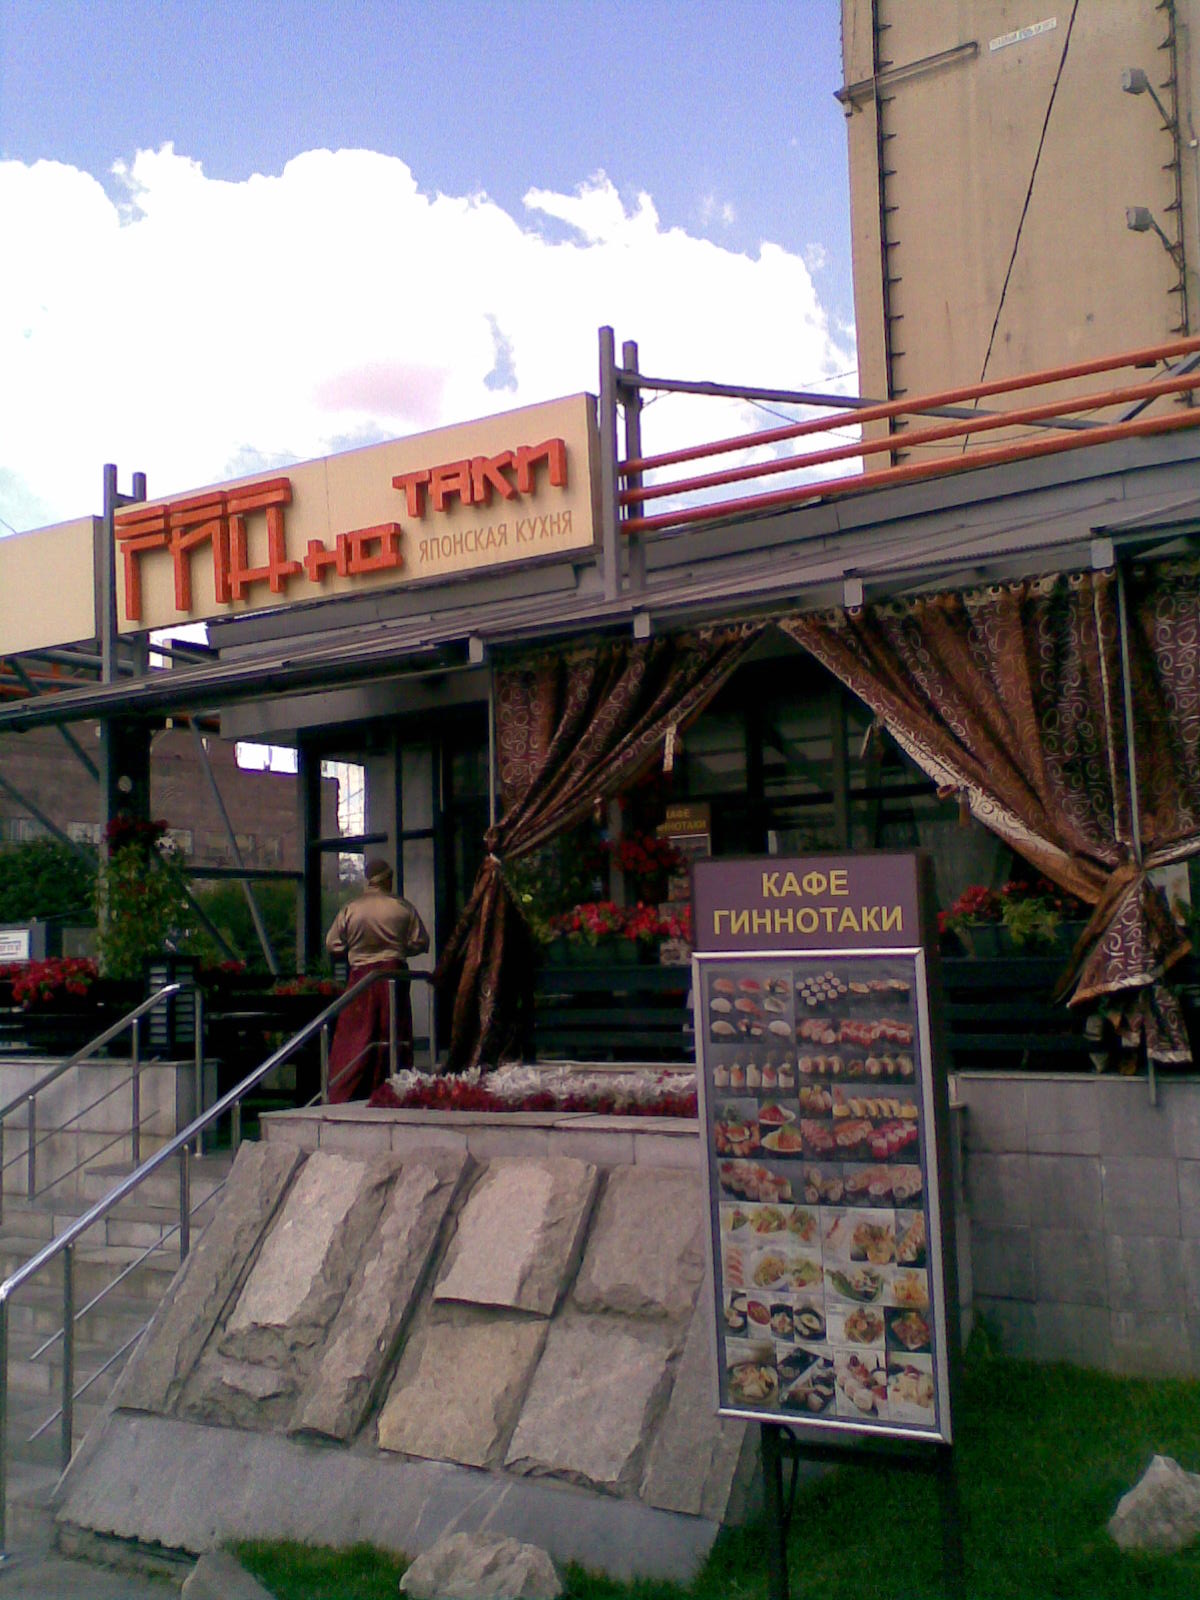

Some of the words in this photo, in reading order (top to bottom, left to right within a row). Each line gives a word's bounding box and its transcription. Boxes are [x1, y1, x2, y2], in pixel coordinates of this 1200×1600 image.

[419, 522, 508, 564] ЯПОНСКАЯ
[515, 510, 573, 544] КУХНЯ
[762, 869, 849, 897] КАФЕ
[713, 905, 903, 935] ГИННОТАКИ
